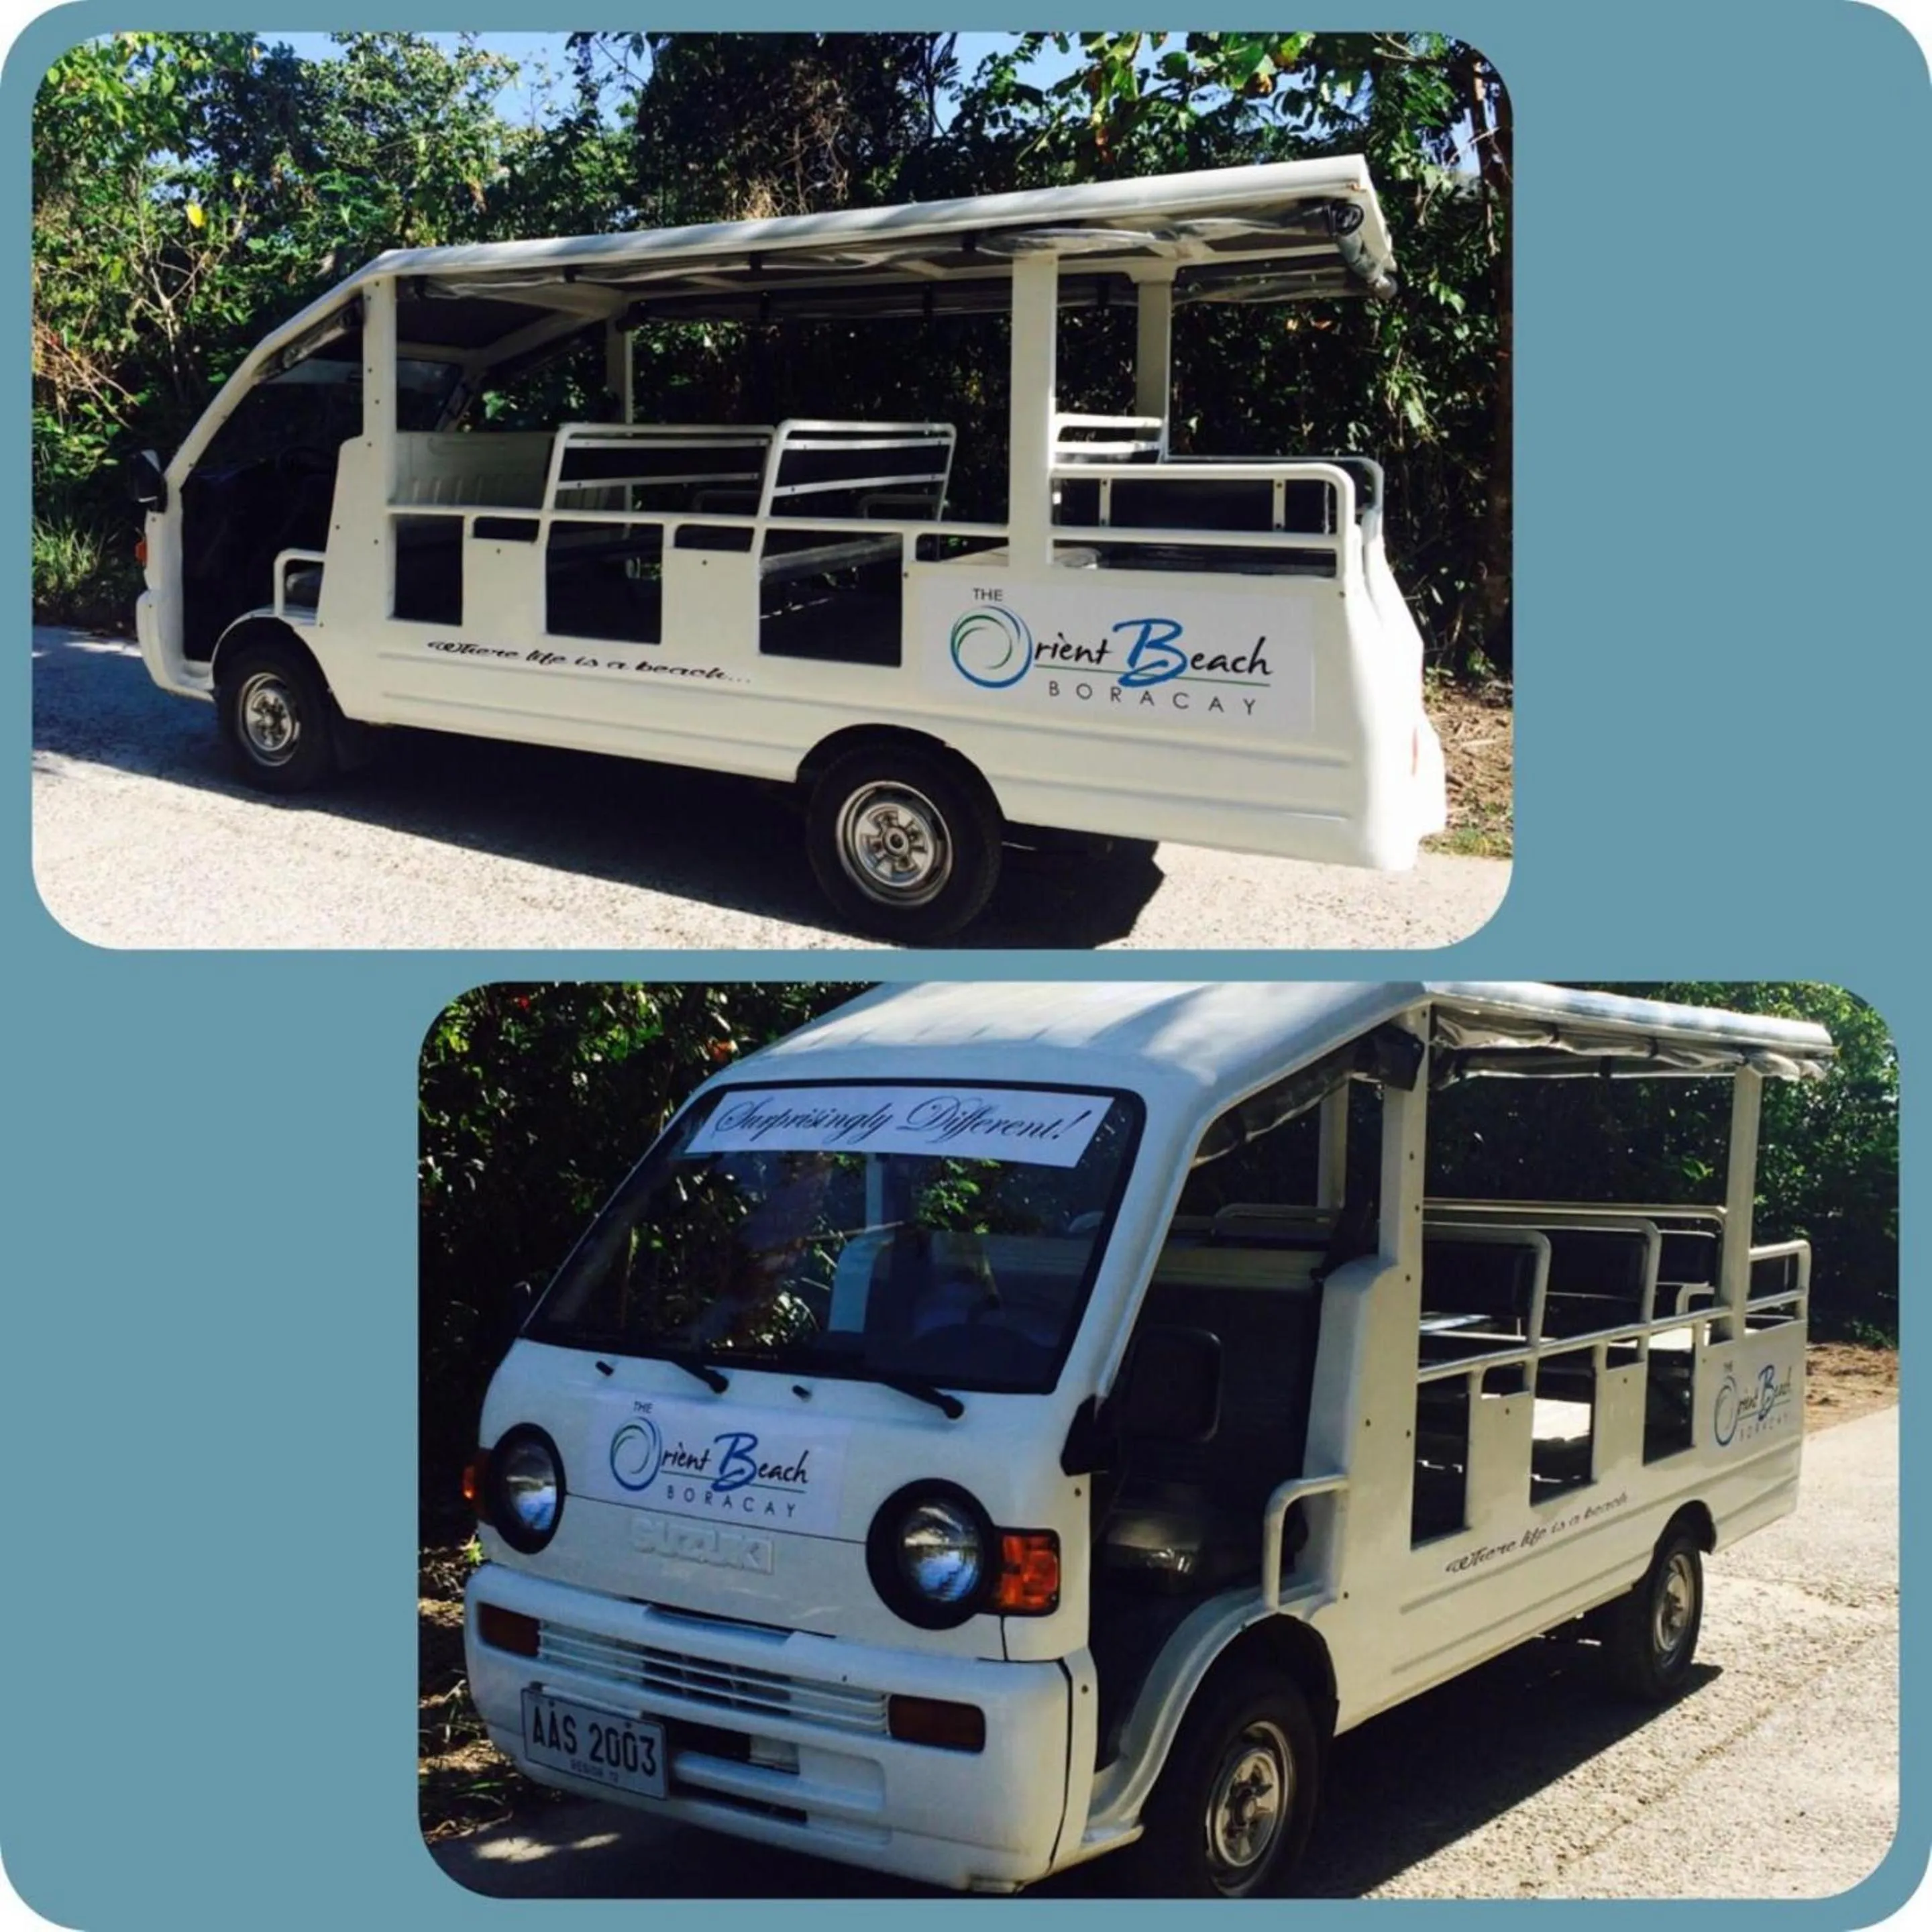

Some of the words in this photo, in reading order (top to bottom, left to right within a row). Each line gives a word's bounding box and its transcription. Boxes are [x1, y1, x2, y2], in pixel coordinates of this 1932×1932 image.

[973, 588, 1004, 602] THE
[427, 640, 520, 661] Where
[525, 649, 567, 666] life
[574, 655, 598, 667] is
[607, 660, 626, 671] a
[950, 604, 1114, 689] Orient
[1112, 617, 1274, 688] Beach
[1049, 680, 1256, 715] BORACAY
[713, 1097, 894, 1144] Surprisingly
[896, 1096, 1092, 1144] Different!
[633, 1401, 653, 1414] THE
[609, 1415, 711, 1492] Orient
[710, 1432, 809, 1493] Beach
[666, 1485, 796, 1517] BORACAY
[533, 1706, 578, 1755] AAS
[588, 1722, 657, 1777] 2003
